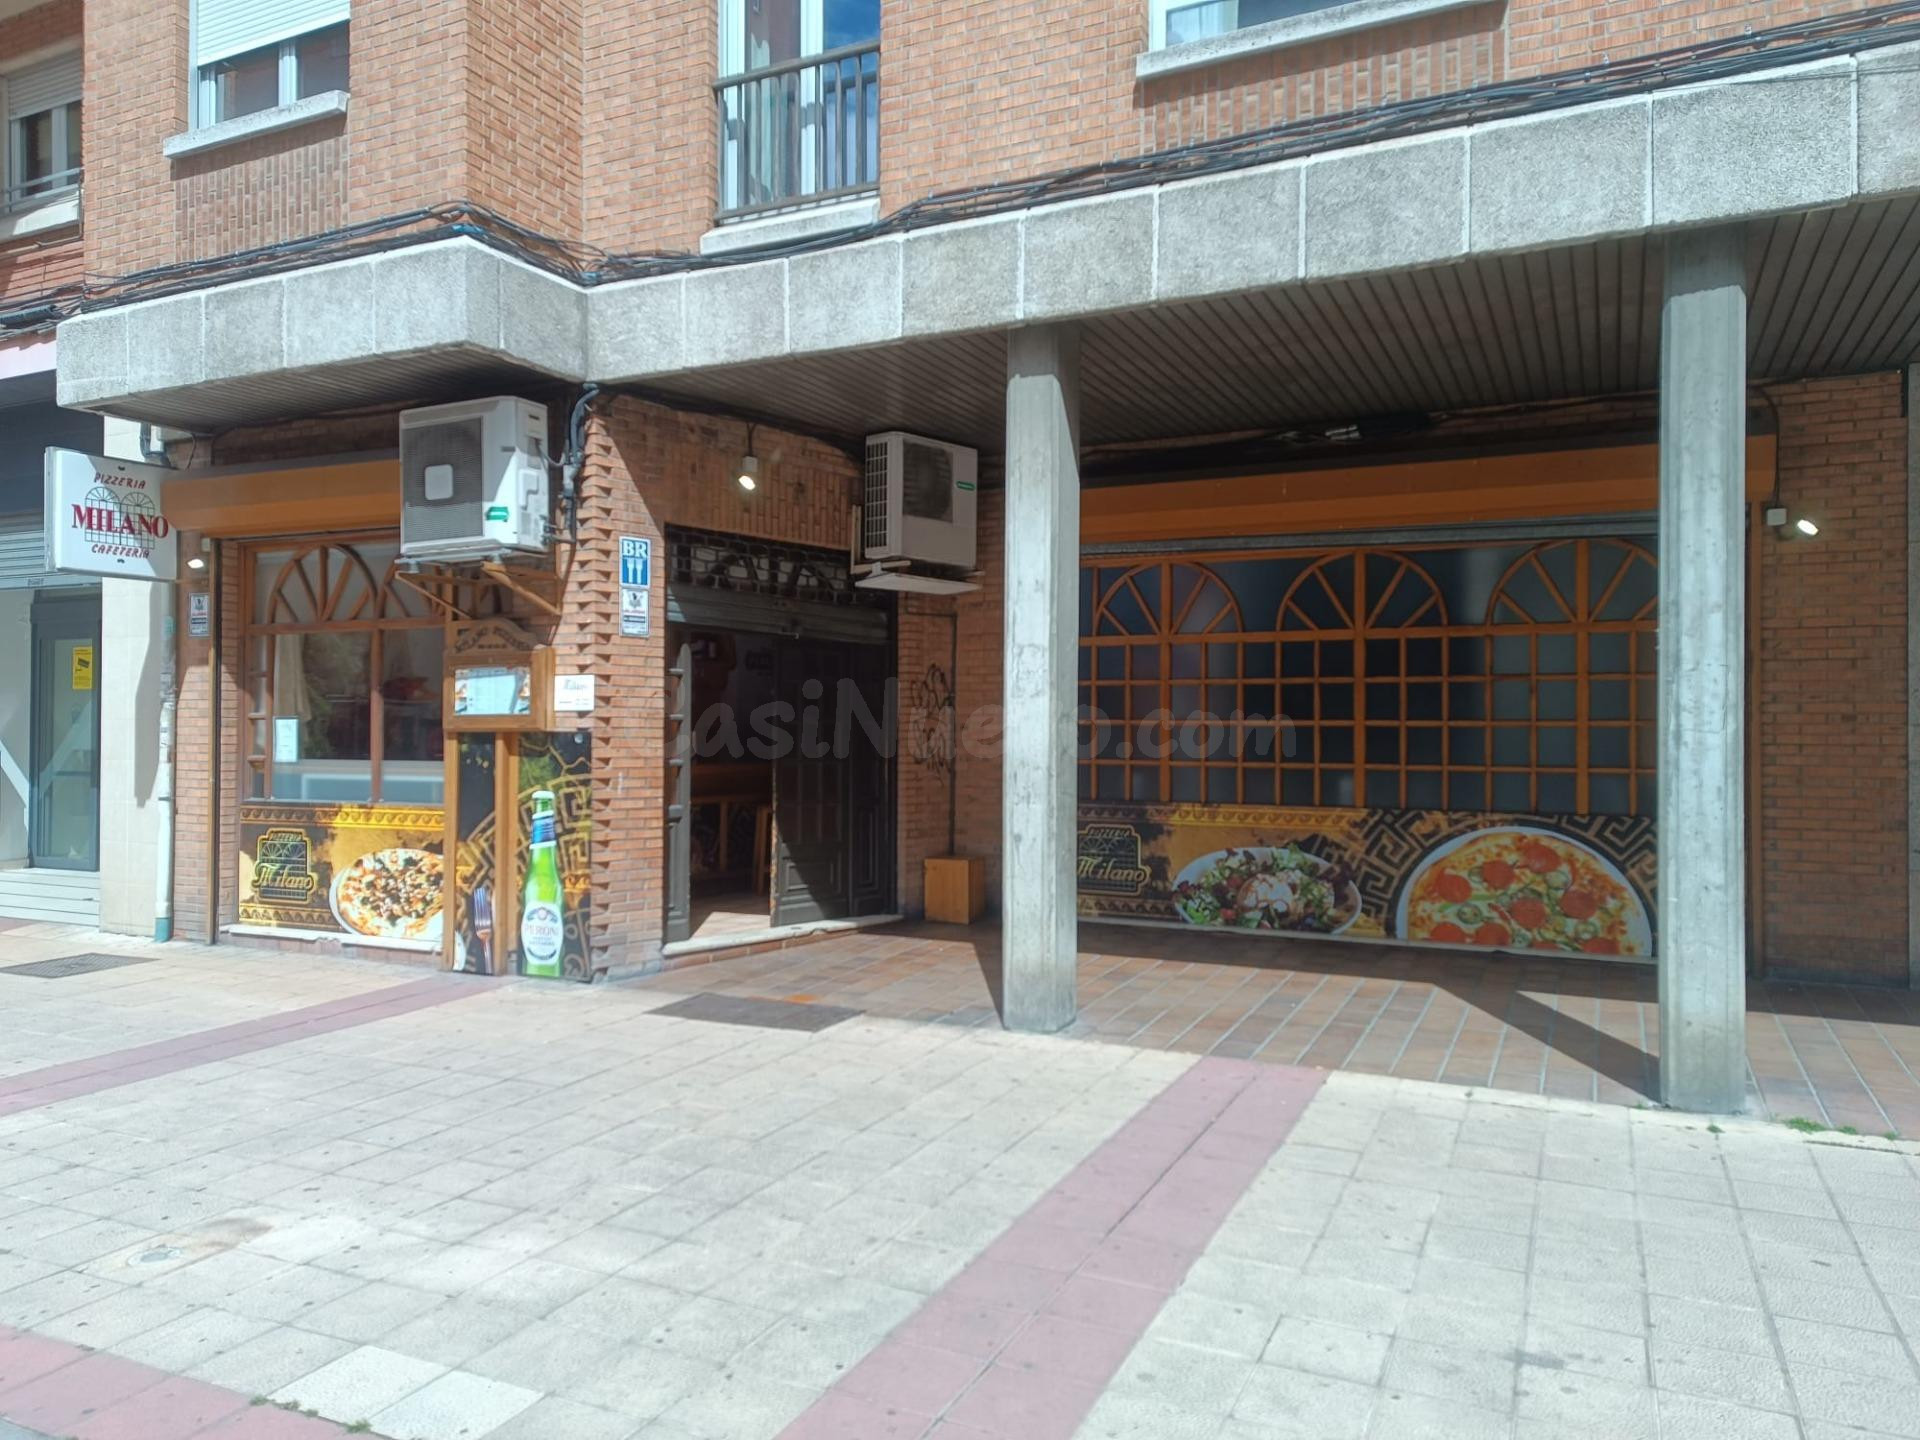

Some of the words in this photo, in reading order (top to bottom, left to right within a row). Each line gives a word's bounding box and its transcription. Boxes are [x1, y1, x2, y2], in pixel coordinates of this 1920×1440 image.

[94, 472, 146, 489] PIZZERIA
[71, 504, 169, 538] MILANO
[623, 540, 647, 558] BR
[252, 863, 313, 889] Milano
[1077, 856, 1145, 881] Milano
